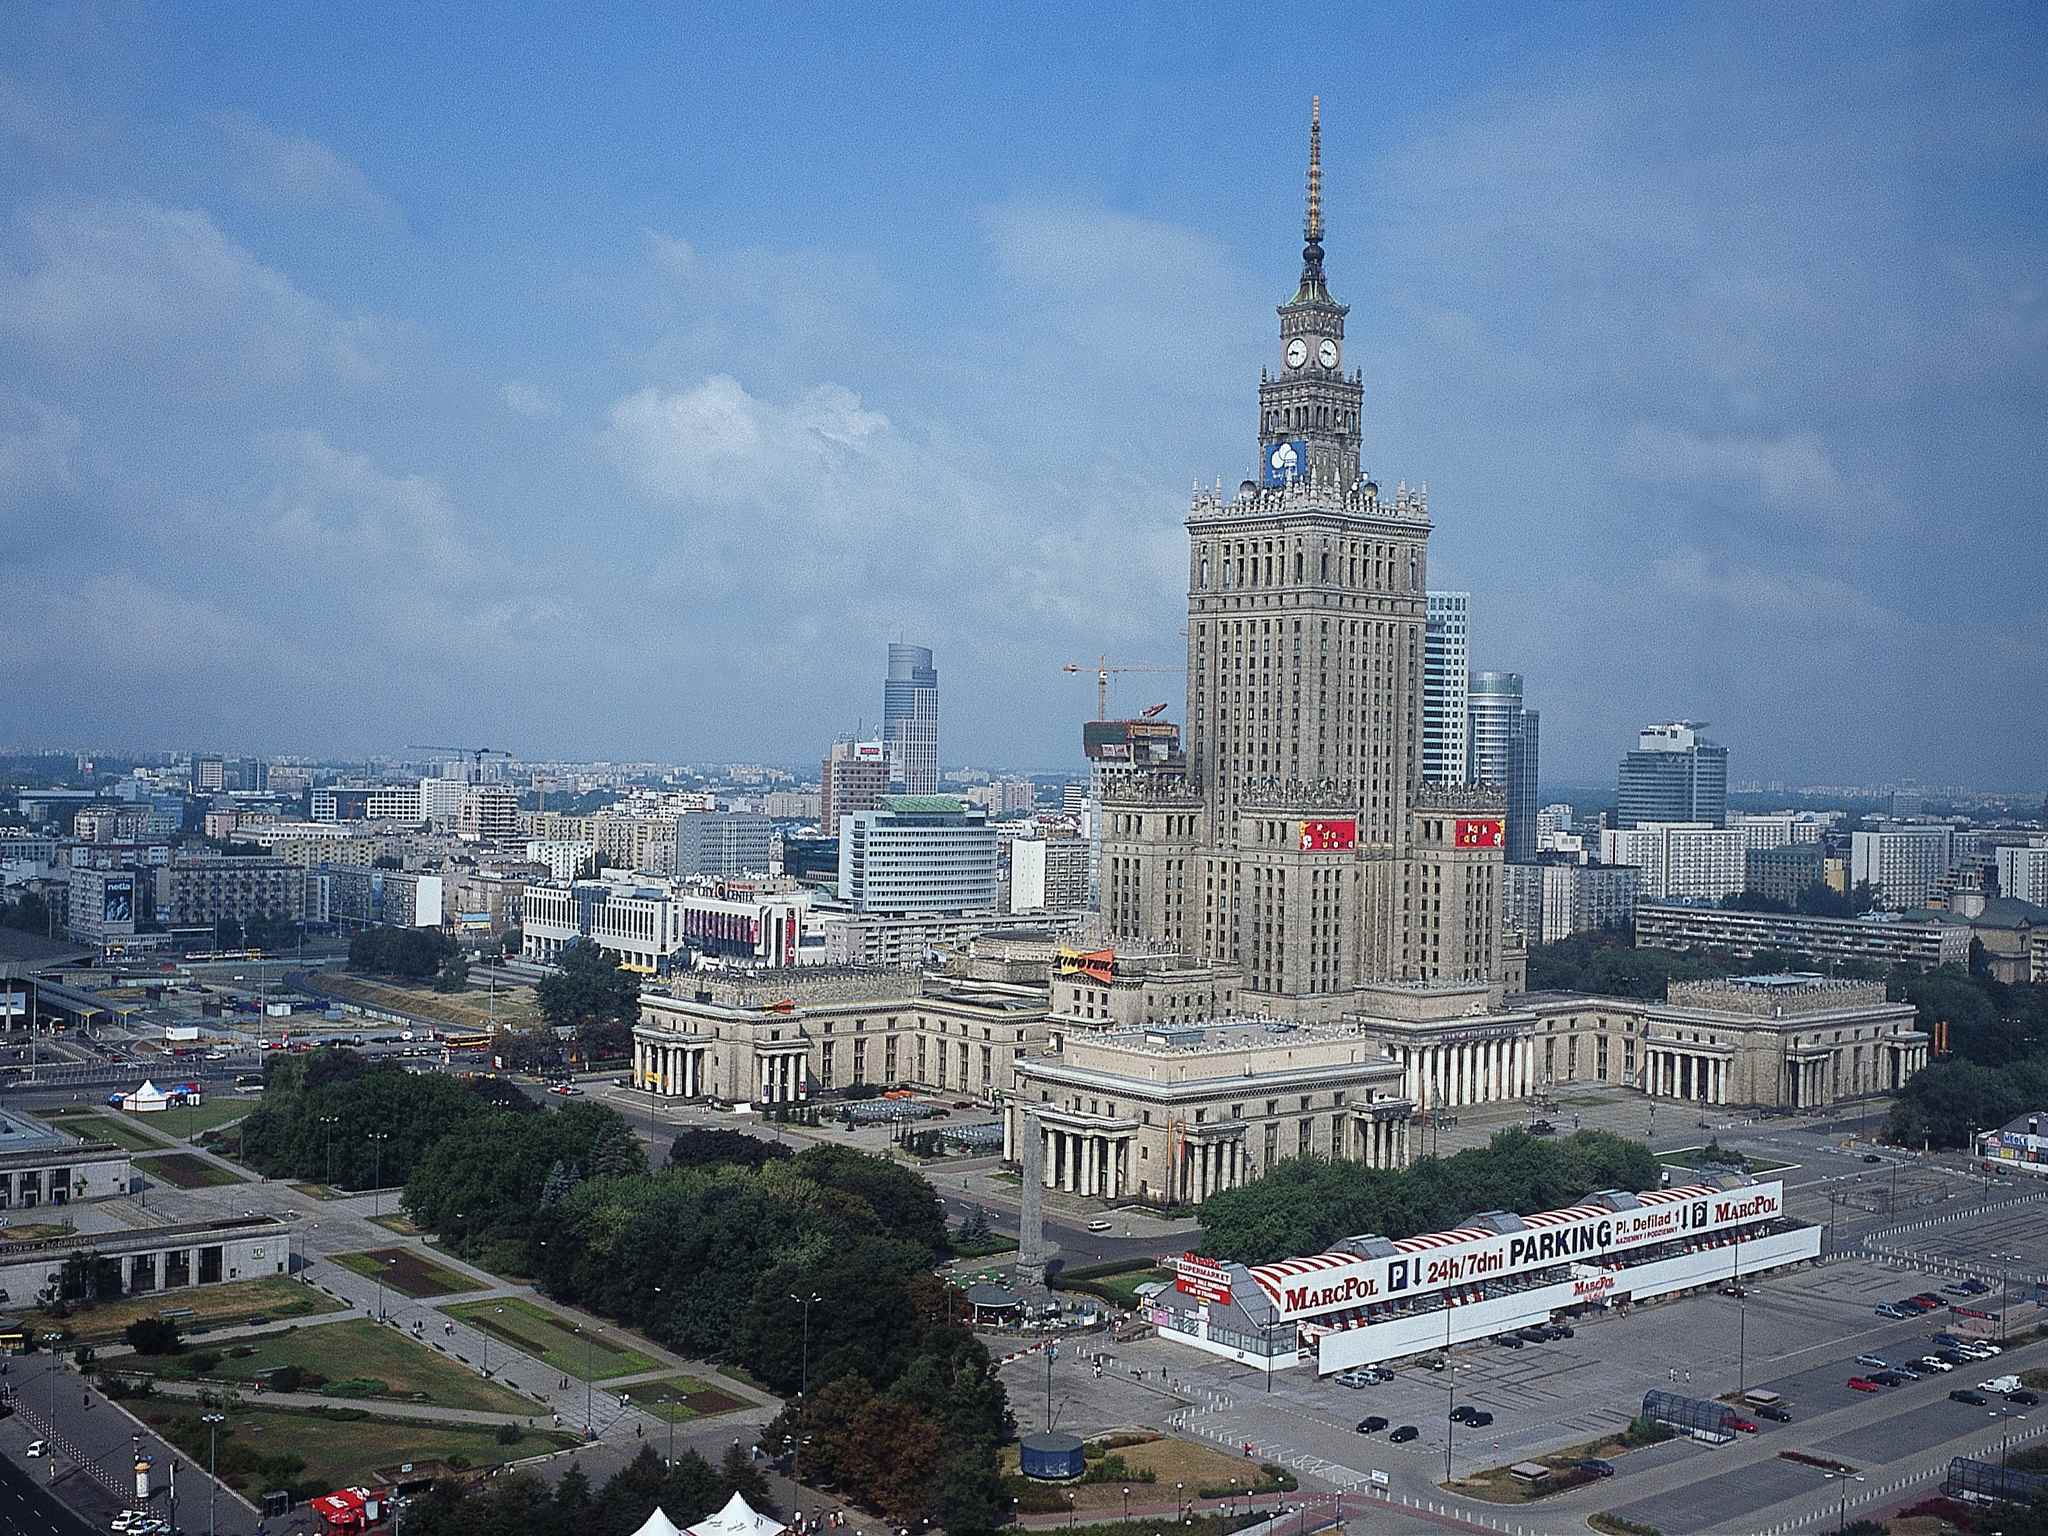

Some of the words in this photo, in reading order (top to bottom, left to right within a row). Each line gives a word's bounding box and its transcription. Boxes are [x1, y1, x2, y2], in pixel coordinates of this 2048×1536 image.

[1616, 1221, 1629, 1235] Pl.
[1633, 1211, 1670, 1231] Defilad
[1427, 1248, 1504, 1283] 24h/7dni
[1510, 1220, 1612, 1266] PARKING
[1178, 1262, 1230, 1283] SUPERMARKET
